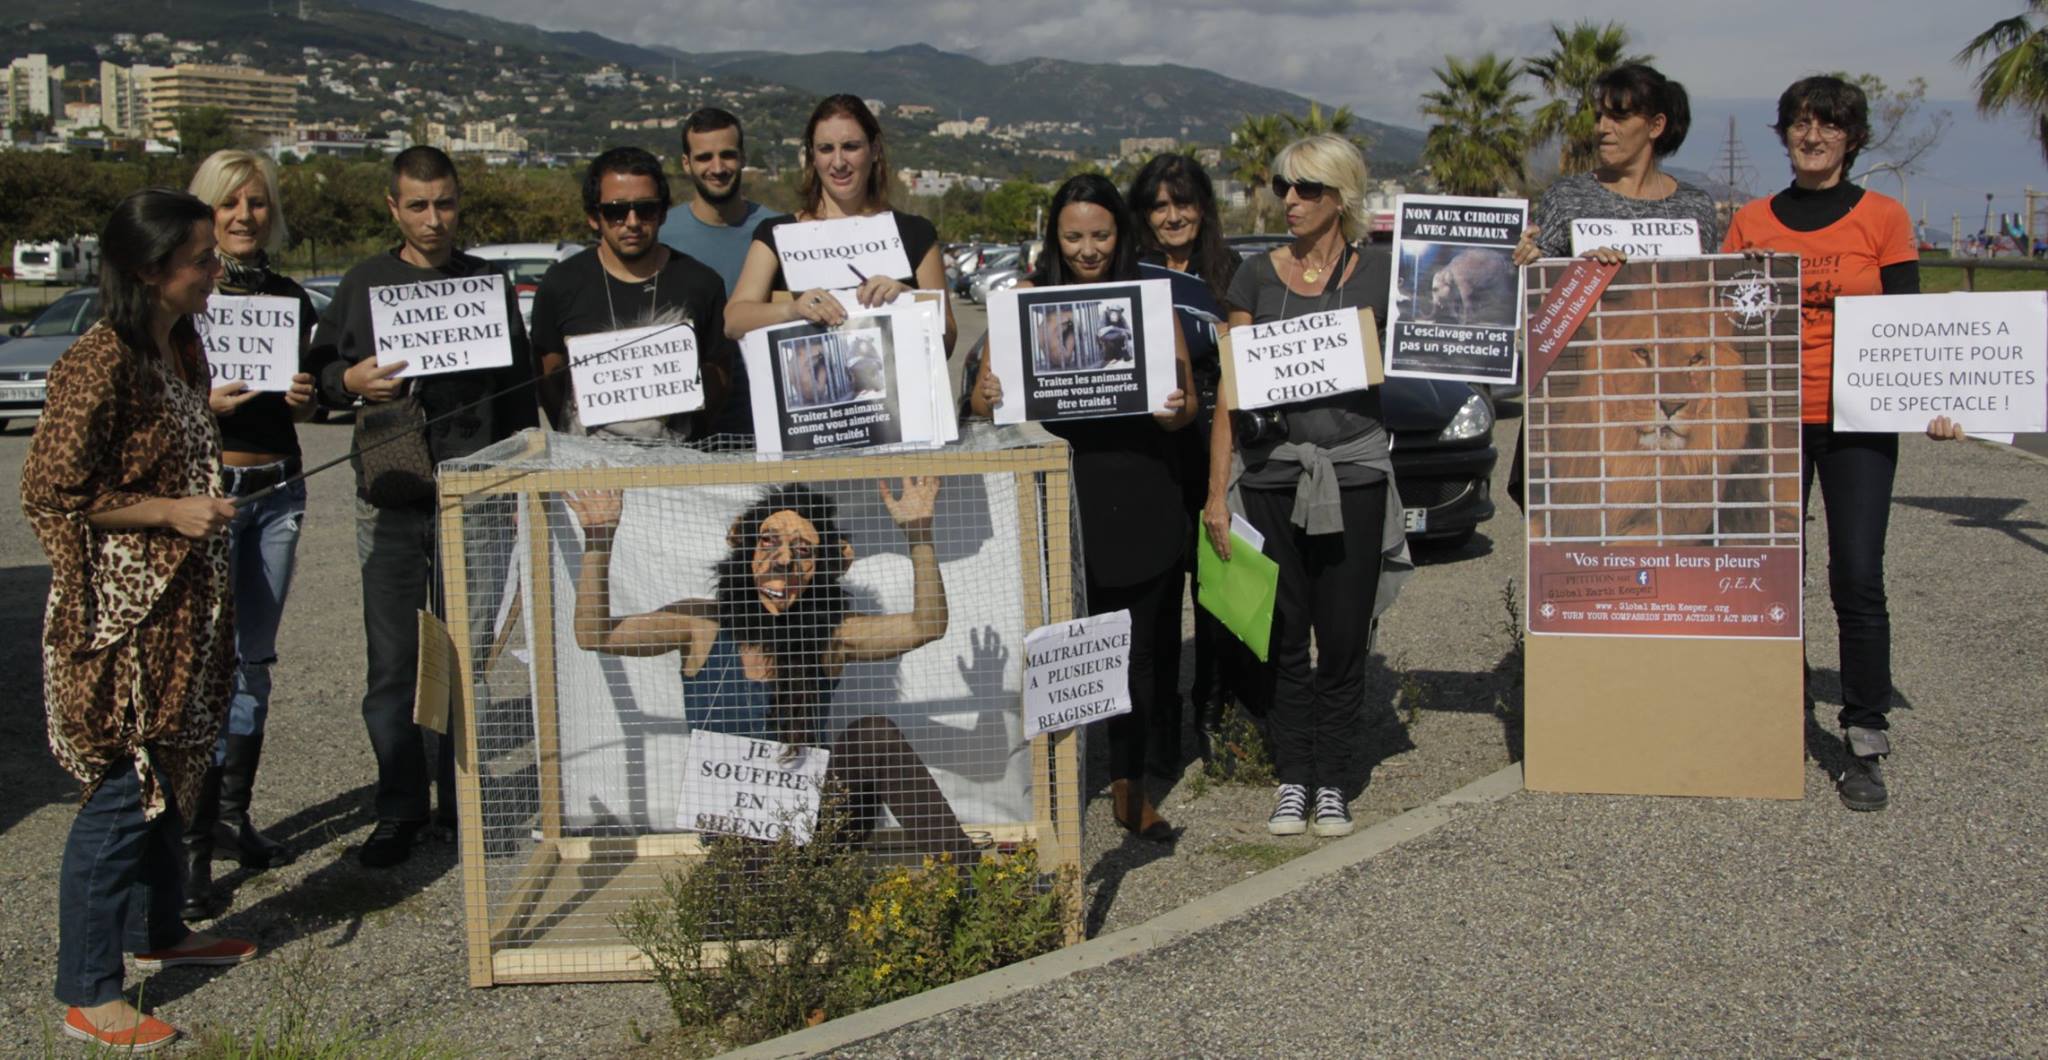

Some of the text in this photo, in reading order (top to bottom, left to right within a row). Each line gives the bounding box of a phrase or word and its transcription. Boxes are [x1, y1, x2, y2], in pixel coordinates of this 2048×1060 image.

[1405, 208, 1520, 225] NON AUX CIRQUES
[1414, 224, 1509, 239] AVEC ANIMAUX
[1577, 222, 1694, 236] VOS RIRES
[782, 237, 900, 262] POURQUOI ?
[1611, 243, 1663, 256] SONT
[378, 277, 495, 307] QUAND ON
[392, 301, 486, 326] AIME ON
[1532, 316, 1551, 334] You
[1547, 297, 1565, 317] like
[1562, 278, 1579, 298] that
[1538, 338, 1556, 353] We
[1553, 315, 1573, 338] don't
[1569, 296, 1586, 315] like
[1584, 276, 1601, 296] that
[240, 309, 295, 328] SUIS
[1252, 325, 1277, 340] LA
[1403, 325, 1508, 342] L'esclavage n'est
[1871, 321, 2010, 338] CONDAMNES A
[203, 336, 274, 354] AS UN
[1247, 333, 1348, 362] N'EST PAS
[1400, 341, 1508, 357] pas un spectacle !
[1859, 346, 2023, 362] PERPETUITE POUR
[420, 351, 469, 369] PAS !
[1274, 359, 1326, 379] MON
[593, 360, 681, 385] C'EST ME
[1037, 372, 1133, 387] Traitez les animaux
[1847, 370, 2035, 388] QUELQUES MINUTES
[583, 379, 697, 408] TORTURER
[1033, 382, 1138, 398] comme vous aimeriez
[1267, 378, 1338, 401] CHOIX
[1057, 395, 1117, 409] être traités !
[1870, 395, 2009, 411] DE SPECTACLE !
[791, 402, 884, 423] Traitez les animaux
[788, 412, 890, 435] comme vous aimeriez
[813, 433, 834, 444] être
[836, 428, 864, 441] traités
[1566, 552, 1767, 572] "Vos rires sont leurs pleurs"
[1619, 602, 1648, 610] Global
[1562, 611, 1584, 620] TURN
[1587, 612, 1609, 620] YOUR
[1611, 612, 1660, 620] COMPASSION
[1664, 613, 1682, 621] INTO
[1686, 614, 1715, 622] ACTION
[1723, 614, 1738, 622] ACT
[1741, 614, 1758, 623] NOW
[1068, 624, 1085, 637] LA
[1025, 633, 1129, 670] MALTRAITANCE
[1030, 655, 1122, 689] A PLUSIEURS
[1048, 680, 1104, 704] VISAGES
[1038, 697, 1117, 729] REAGISSEZ!
[742, 741, 771, 761] JE
[700, 760, 808, 791] SOUFFRE
[734, 791, 766, 810] EN
